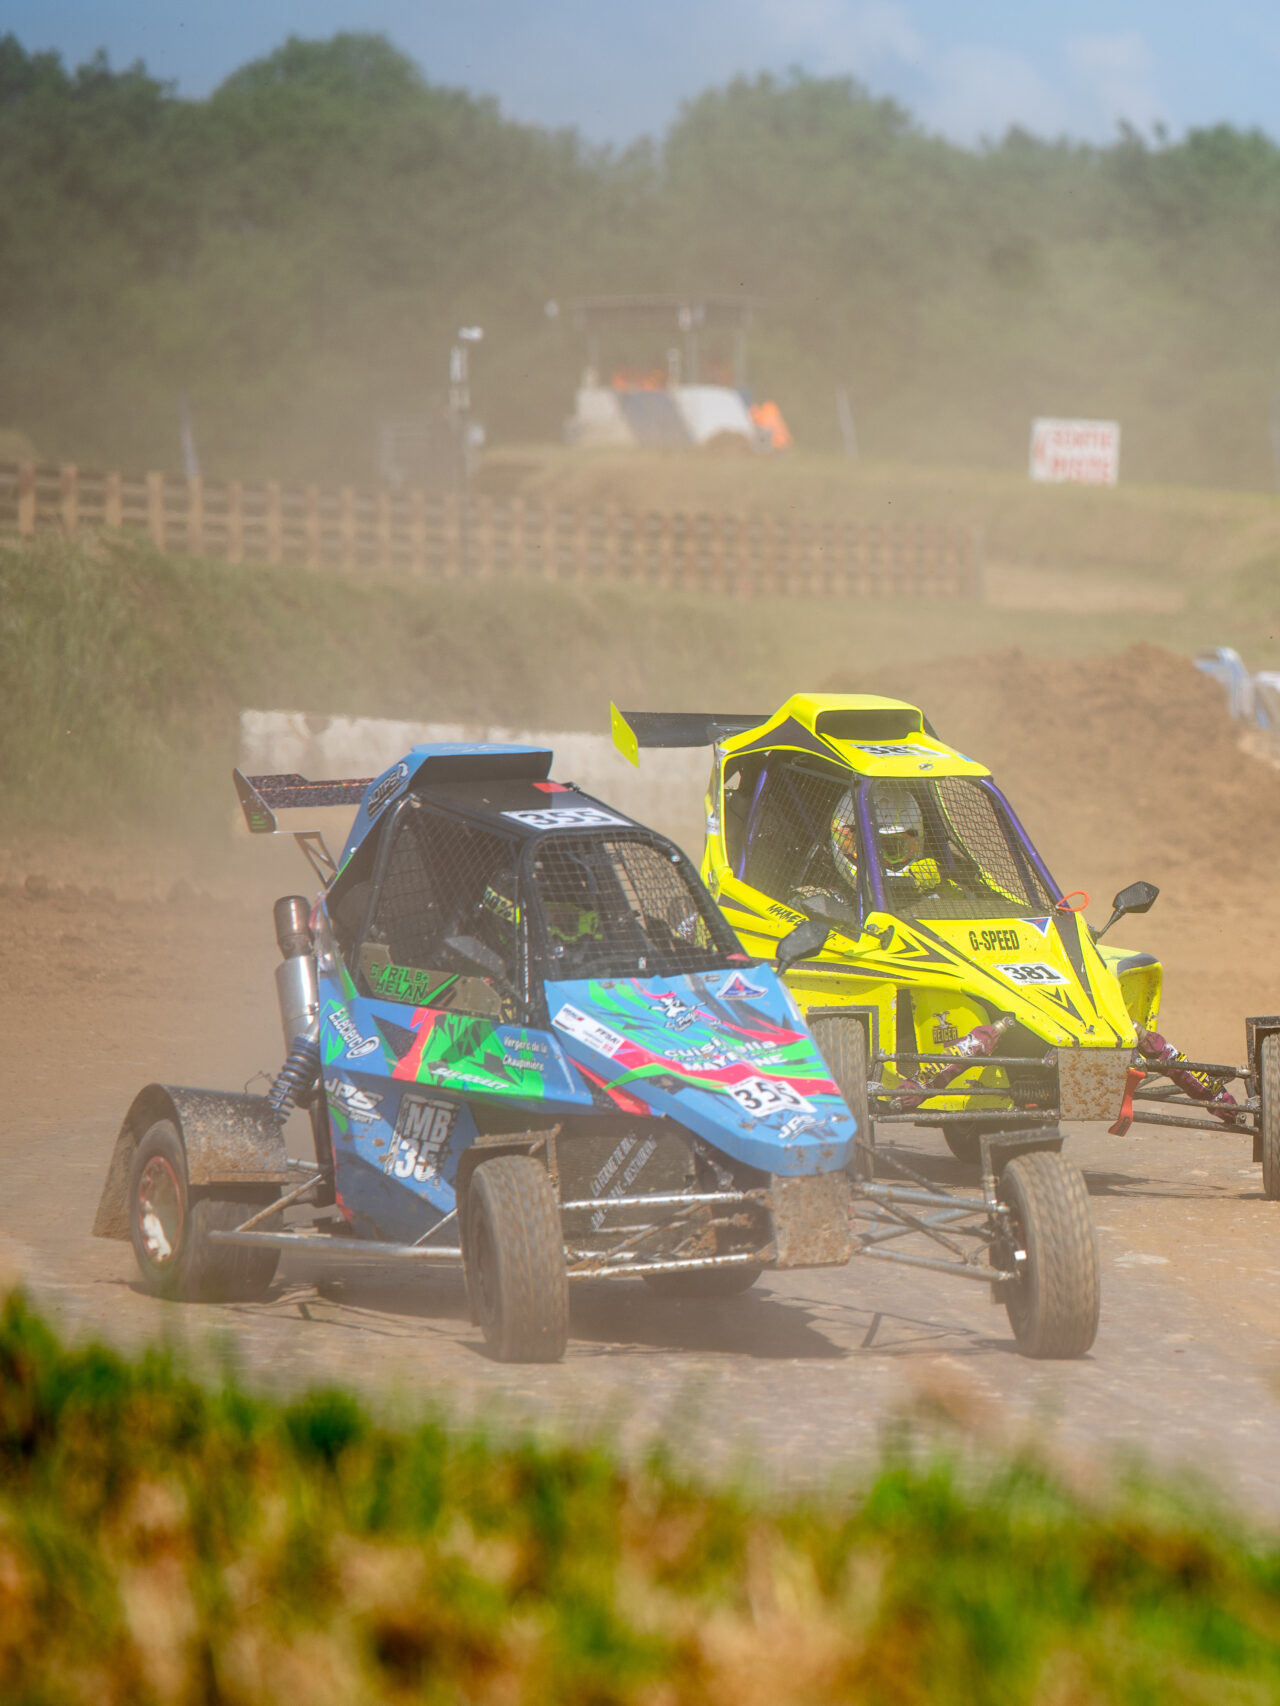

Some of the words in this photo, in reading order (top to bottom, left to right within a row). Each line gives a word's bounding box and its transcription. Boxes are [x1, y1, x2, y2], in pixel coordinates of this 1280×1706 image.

[517, 809, 614, 826] 355
[968, 929, 1020, 951] G-SPEED
[1003, 966, 1061, 980] 381
[324, 1077, 384, 1110] JPS
[733, 1081, 801, 1110] 355
